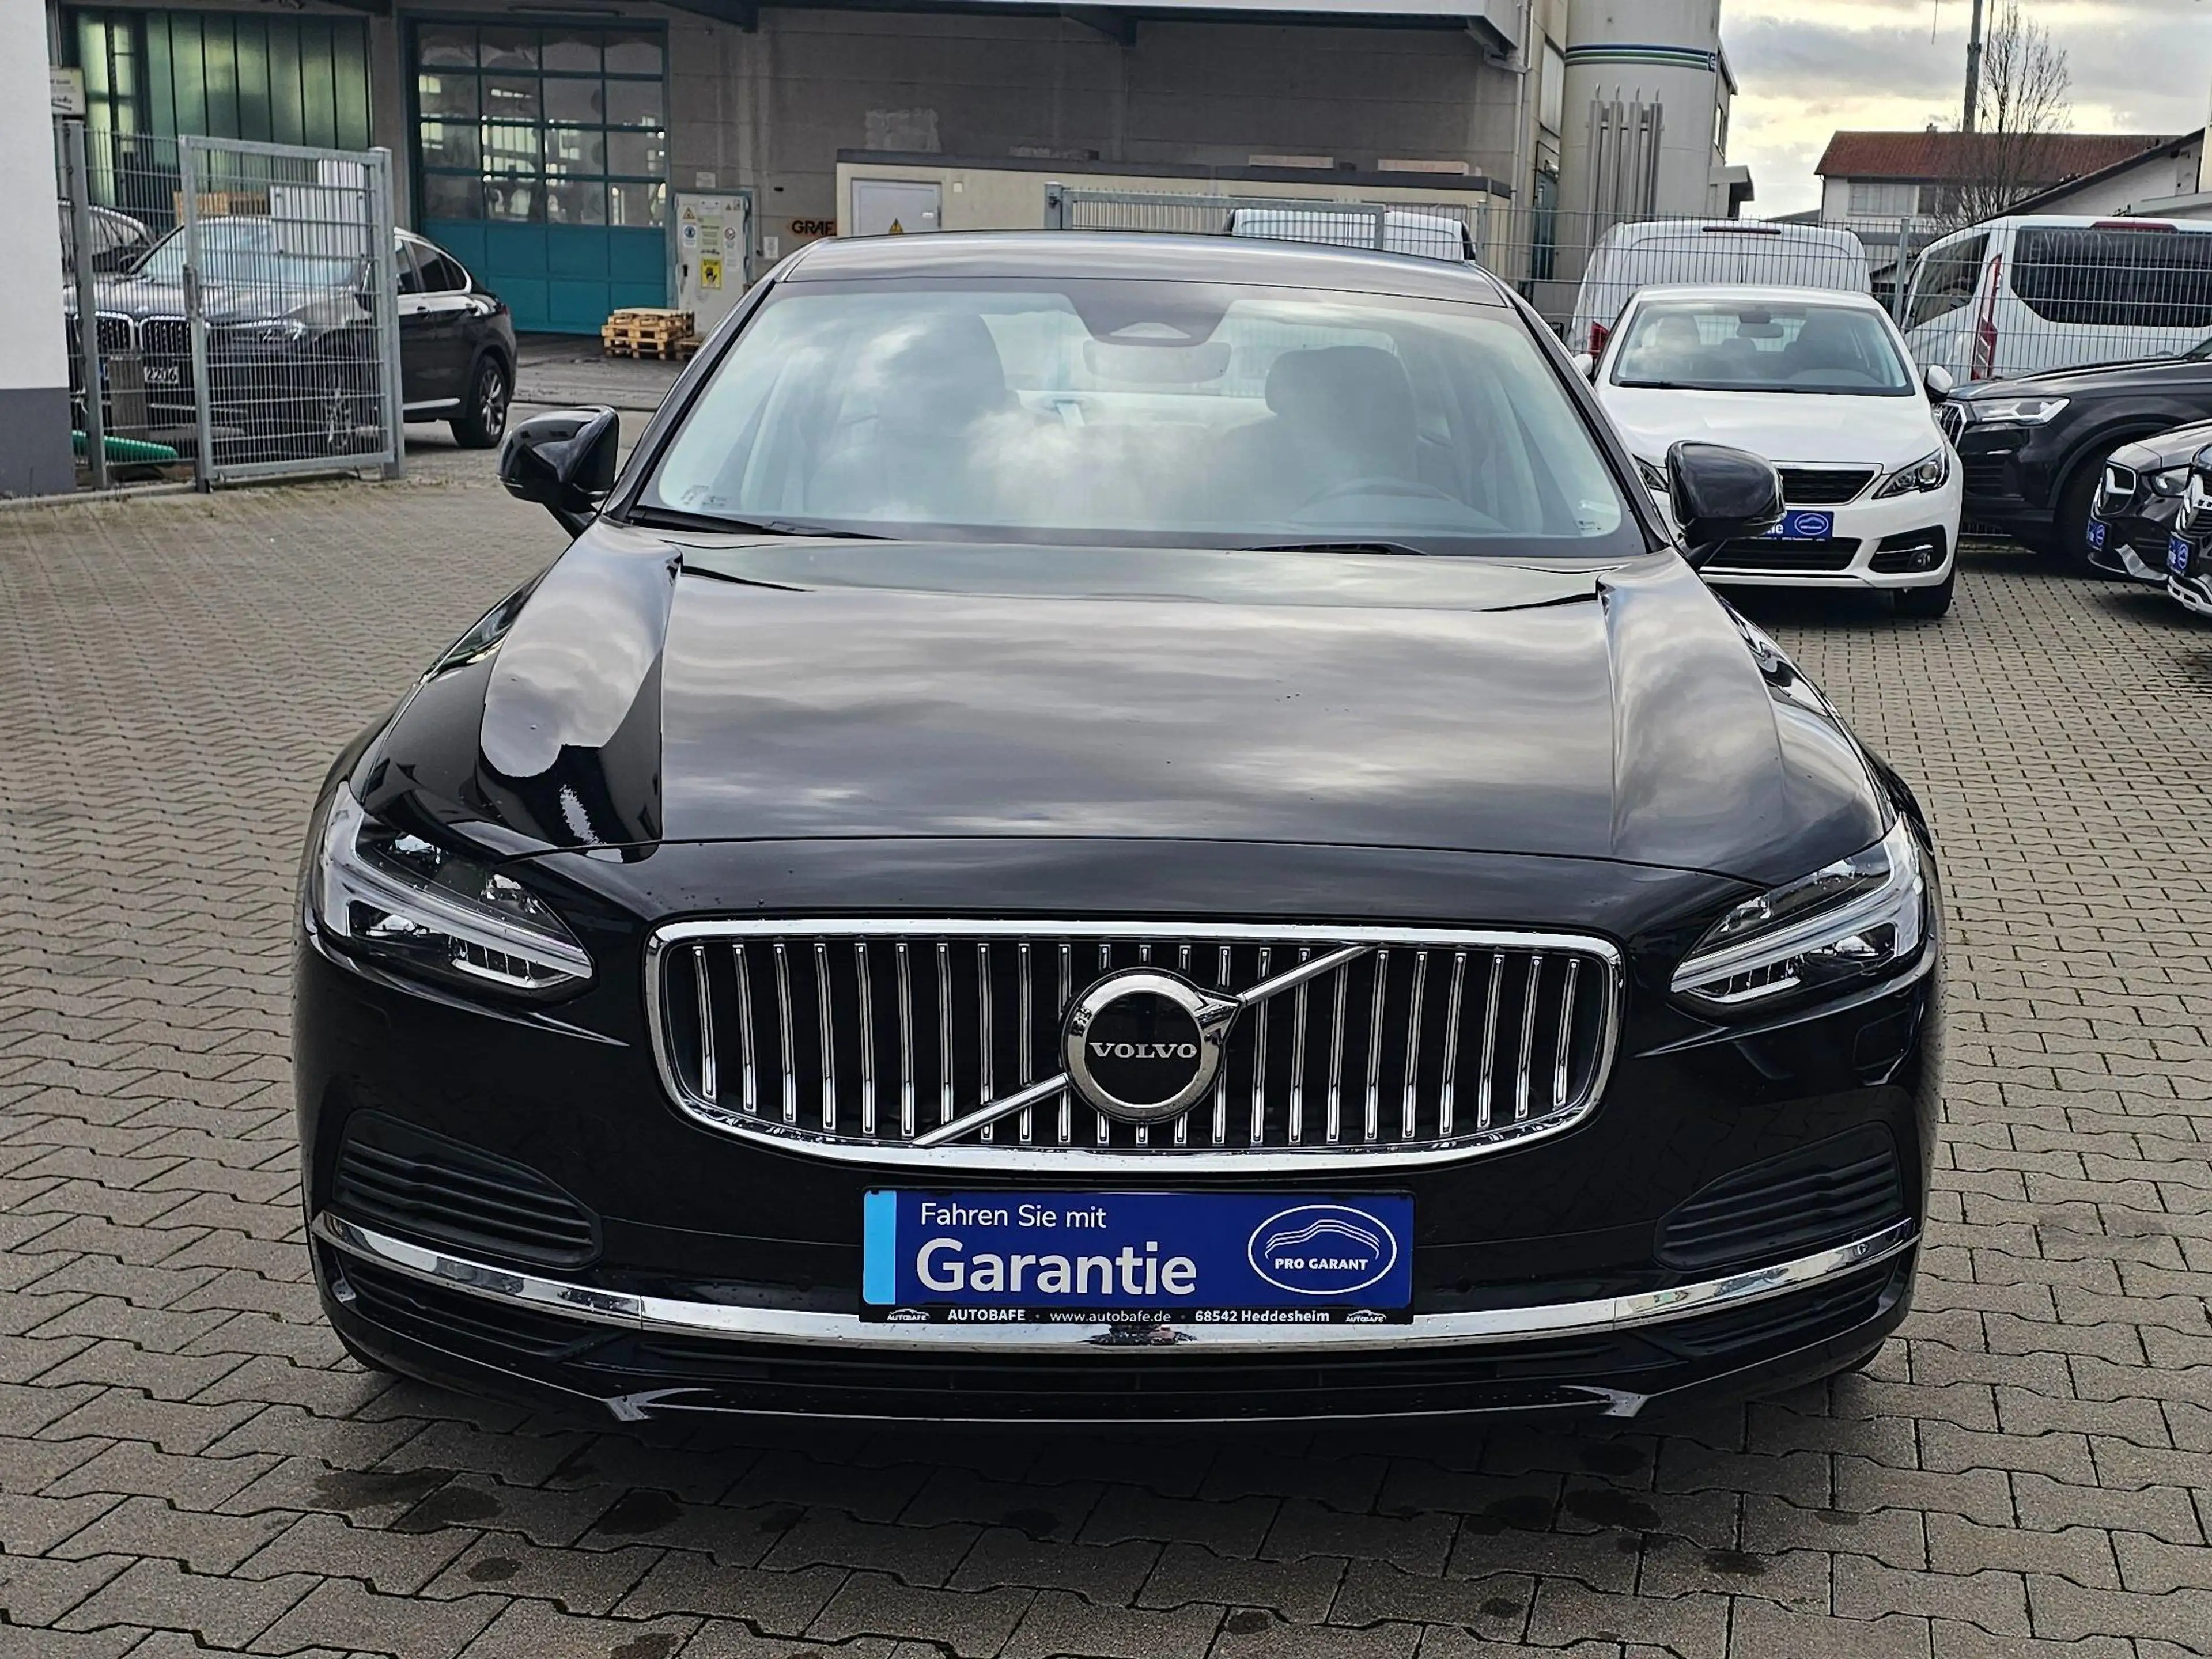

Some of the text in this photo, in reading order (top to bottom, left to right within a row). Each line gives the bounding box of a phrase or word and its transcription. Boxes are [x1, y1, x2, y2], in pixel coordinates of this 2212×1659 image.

[1088, 1042, 1197, 1058] VOLVO
[921, 1202, 1107, 1229] Fahren Sie mit
[916, 1237, 1197, 1296] Garantie
[1275, 1258, 1369, 1271] PRO GARANT
[947, 1309, 1330, 1323] AUTOBAFE www.autobafe.de 68542 Heddesheim
